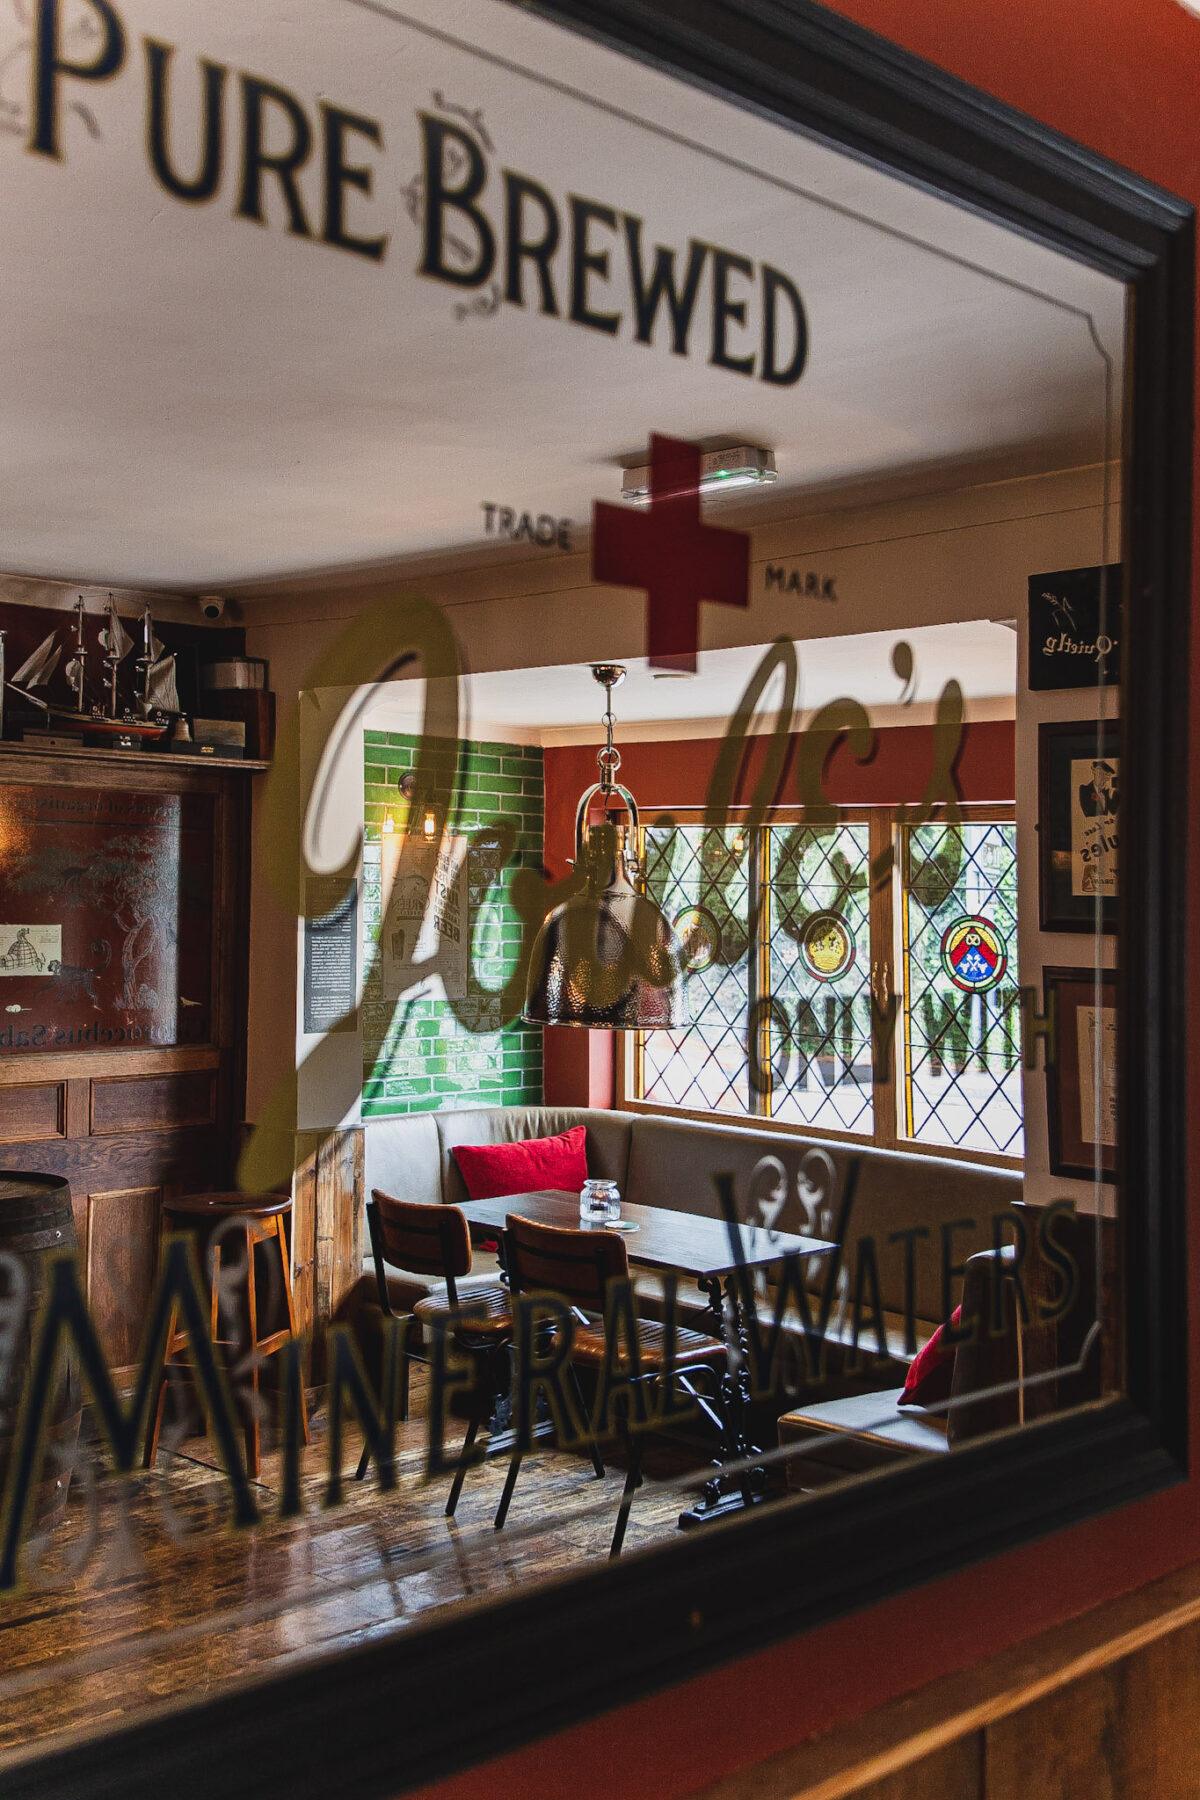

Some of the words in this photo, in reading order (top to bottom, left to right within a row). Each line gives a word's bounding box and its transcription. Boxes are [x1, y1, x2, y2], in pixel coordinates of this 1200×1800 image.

[27, 0, 390, 263] PURE
[416, 108, 811, 388] BREWED
[480, 500, 574, 552] TRADE
[763, 562, 838, 602] MARK
[748, 994, 901, 1093] ONLY
[922, 985, 1055, 1077] WITH
[0, 1229, 700, 1590] MINERAL
[711, 1157, 1082, 1398] WATERS
